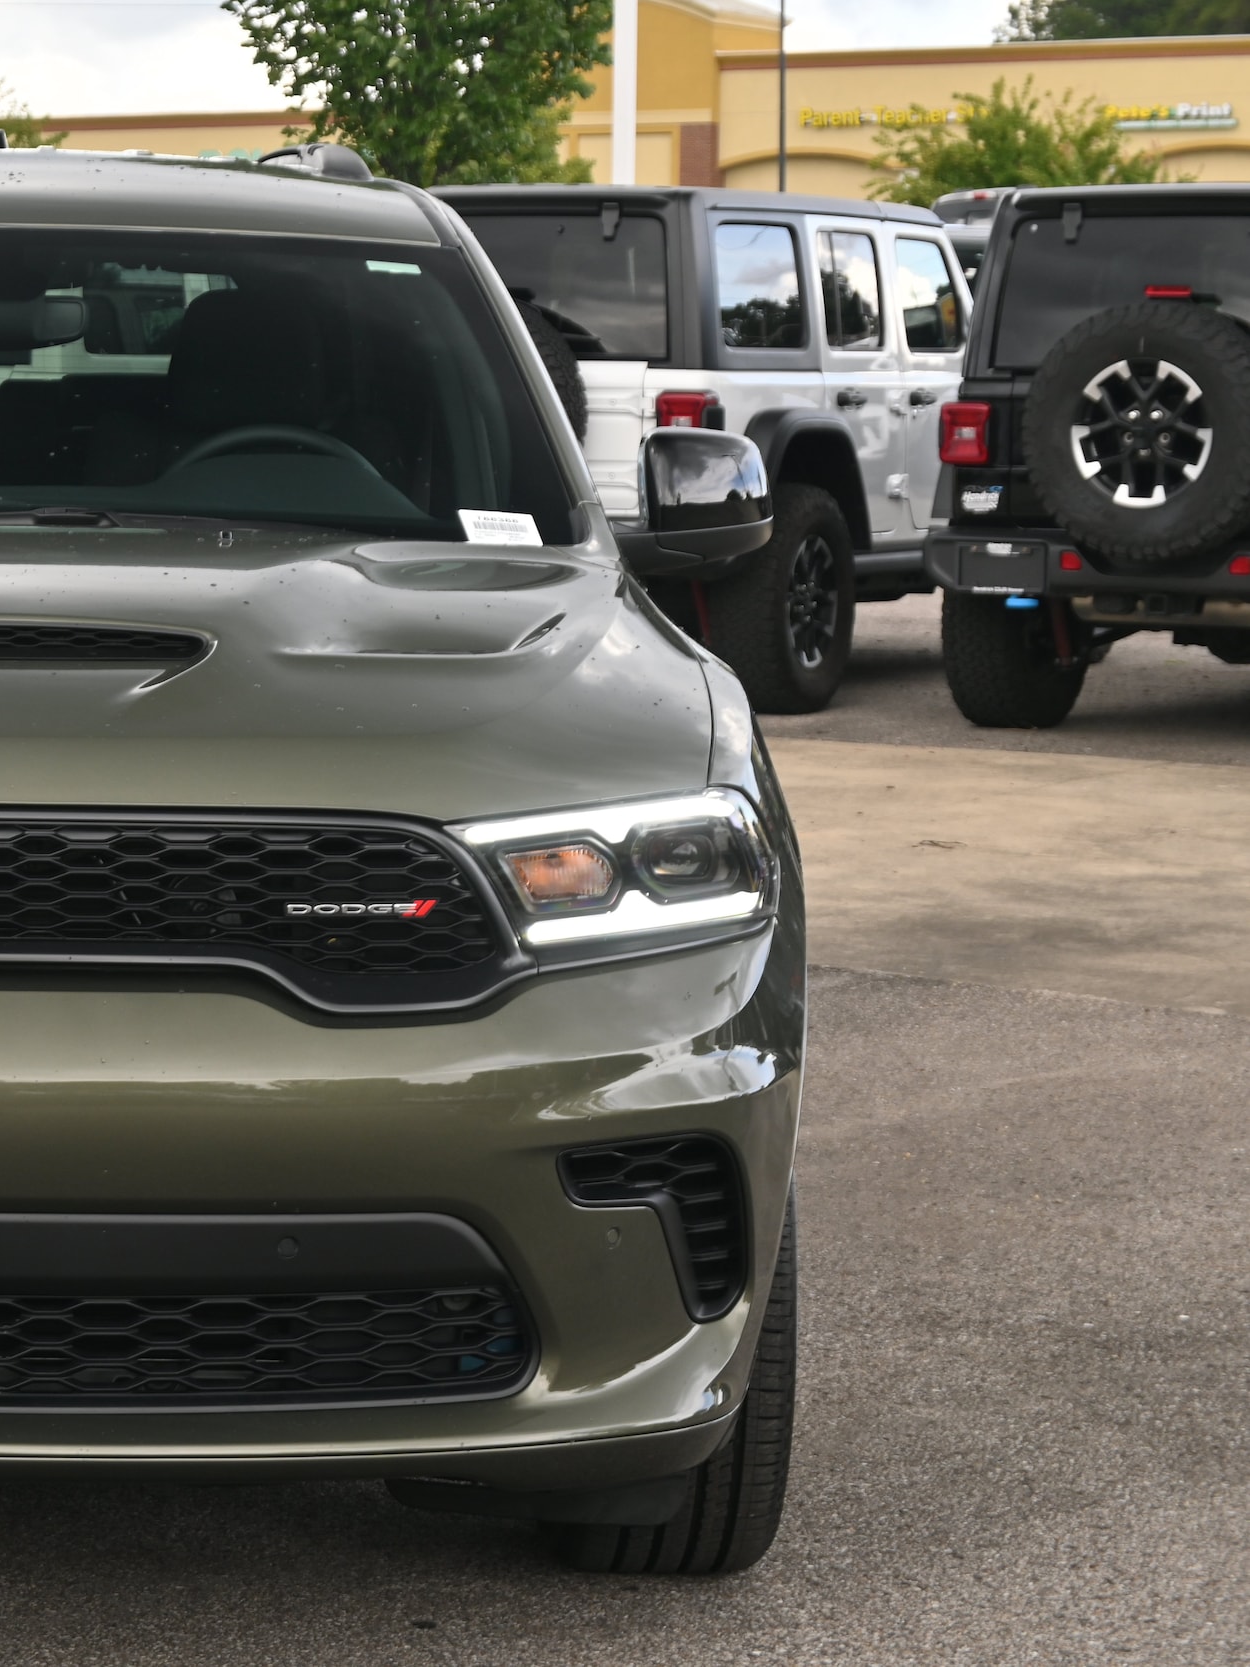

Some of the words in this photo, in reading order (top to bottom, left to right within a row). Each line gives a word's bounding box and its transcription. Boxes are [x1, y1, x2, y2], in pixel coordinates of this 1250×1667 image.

[1177, 102, 1232, 116] Print
[799, 107, 861, 127] Parent
[287, 904, 417, 914] DODGE
